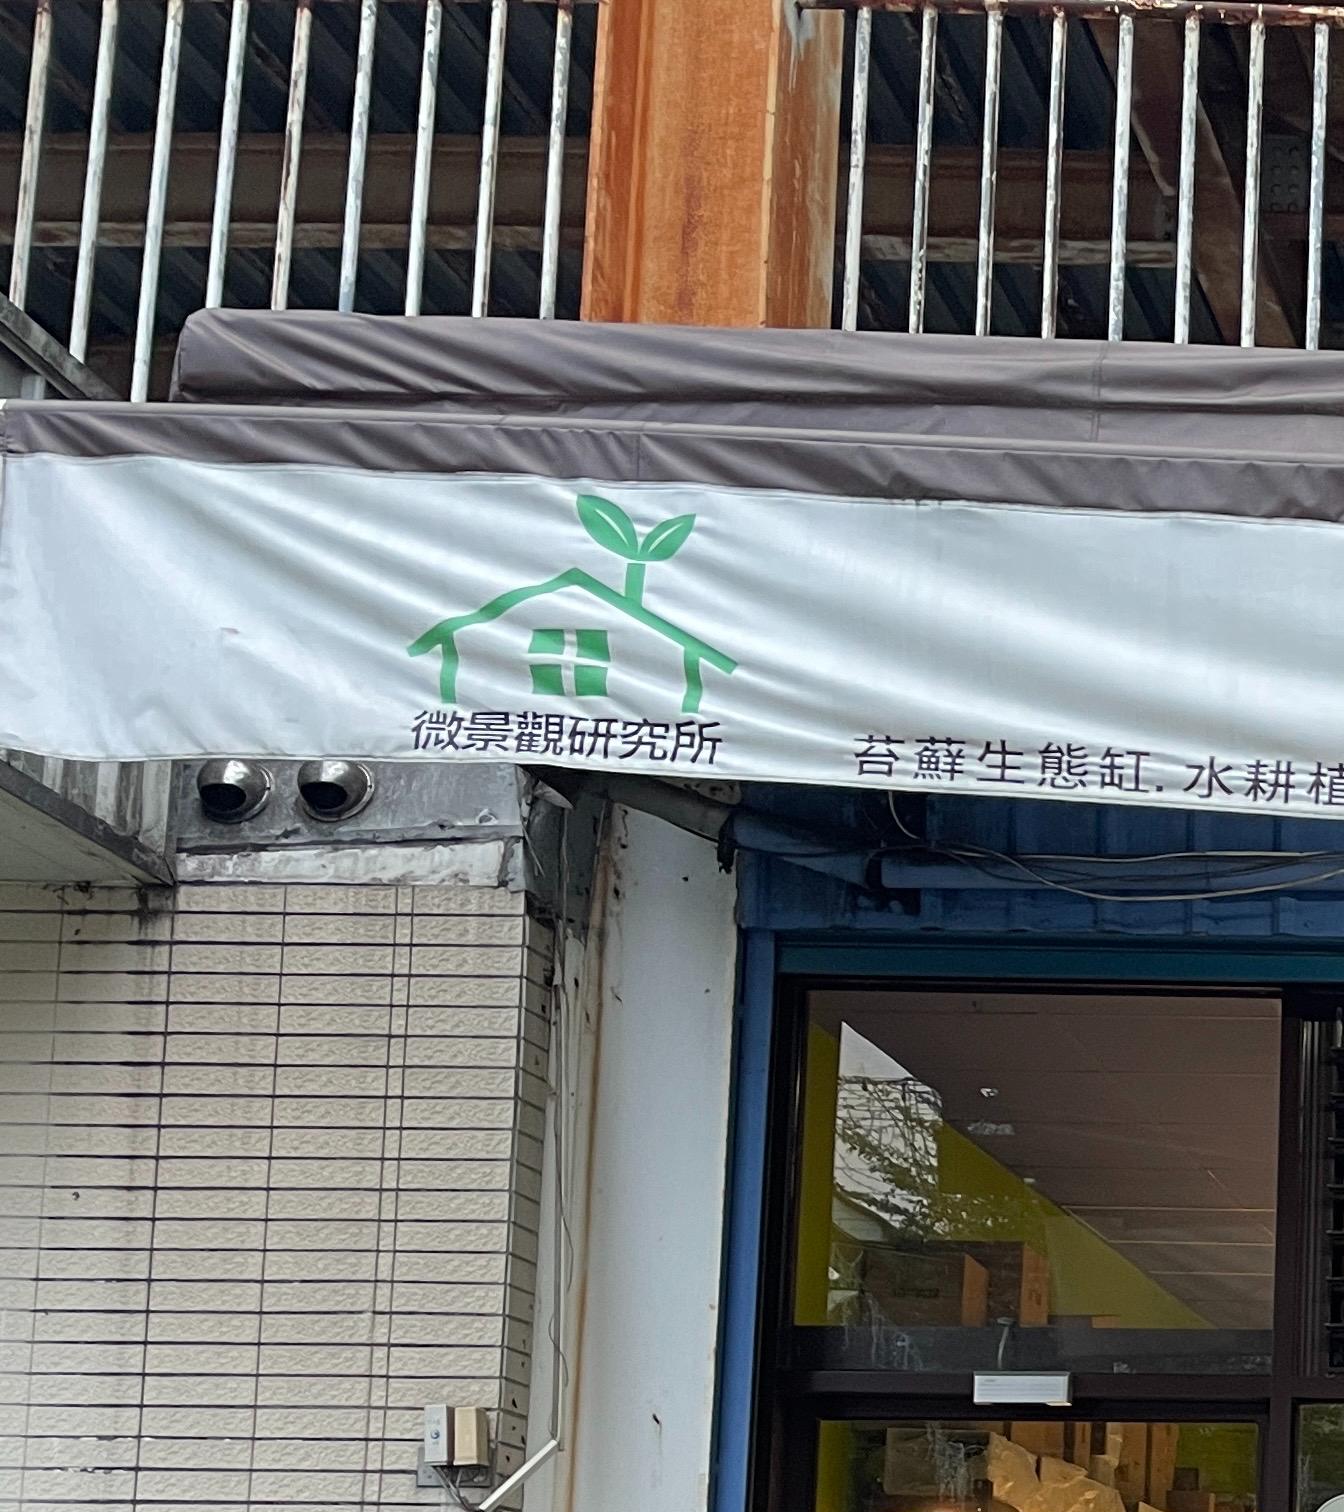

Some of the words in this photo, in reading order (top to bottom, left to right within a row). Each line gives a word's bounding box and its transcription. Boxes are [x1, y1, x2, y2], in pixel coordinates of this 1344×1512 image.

[411, 709, 724, 765] 微景觀研究所
